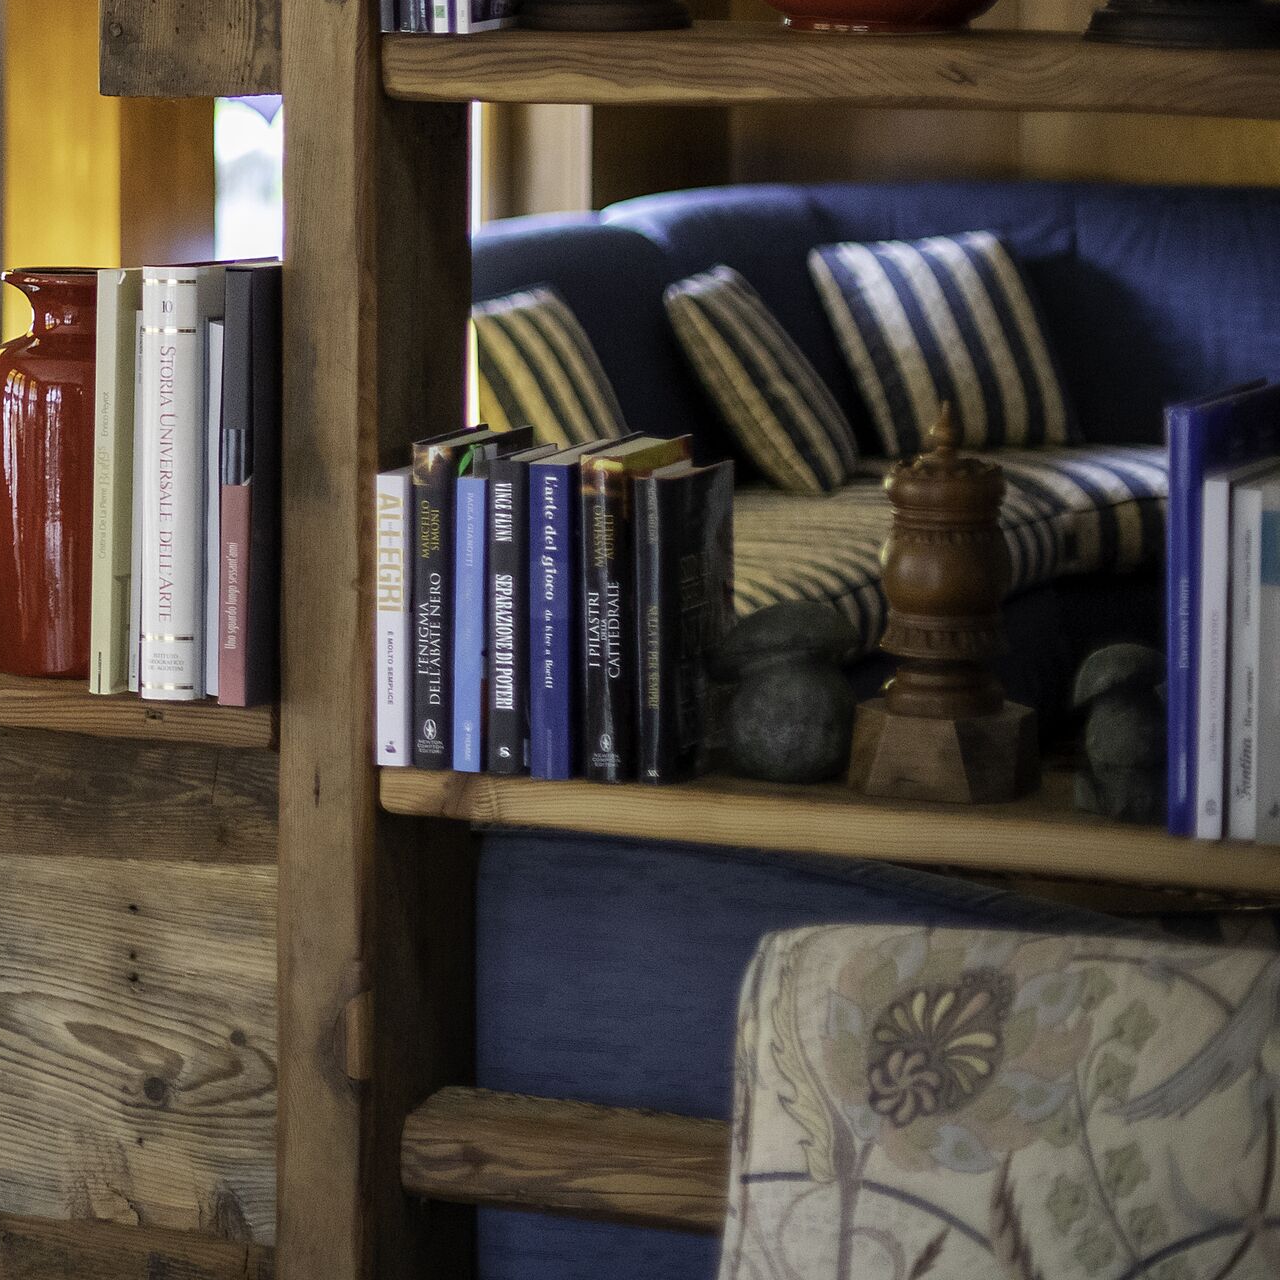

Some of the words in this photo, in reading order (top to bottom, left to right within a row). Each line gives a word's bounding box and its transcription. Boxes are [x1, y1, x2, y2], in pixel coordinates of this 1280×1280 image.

[161, 299, 174, 314] 10
[159, 345, 177, 407] STORIA
[101, 392, 110, 414] Peyrot
[101, 415, 109, 437] Enrico
[159, 413, 178, 522] UNIVERSALE
[495, 482, 513, 511] VINCE
[544, 476, 558, 519] L'arte
[98, 532, 107, 559] Cristina
[420, 498, 431, 559] MARCELLO
[431, 508, 441, 551] SIMONI
[495, 512, 513, 543] FLYNN
[544, 522, 558, 552] del
[593, 504, 604, 569] MASSIMO
[225, 542, 238, 584] sessant'anni
[377, 492, 403, 612] ALLEGRI
[158, 529, 175, 623] DELL'ARTE
[225, 585, 240, 605] lungo
[429, 571, 442, 614] NERO
[541, 555, 558, 602] gioco
[225, 606, 239, 635] sguardo
[495, 573, 514, 650] SEPARAZIONE
[544, 608, 554, 622] da
[588, 591, 600, 658] PILASTRI
[600, 618, 608, 641] DELLA
[607, 581, 620, 679] CATTEDRALE
[224, 635, 236, 650] Uno
[418, 601, 430, 675] L'ENIGMA
[544, 622, 554, 648] Klee
[429, 616, 441, 706] DELL'ABATE
[495, 651, 514, 667] DI
[647, 650, 659, 669] PER
[495, 668, 515, 711] POTERI
[647, 671, 659, 710] SEMPRE
[1235, 736, 1253, 800] Fontina
